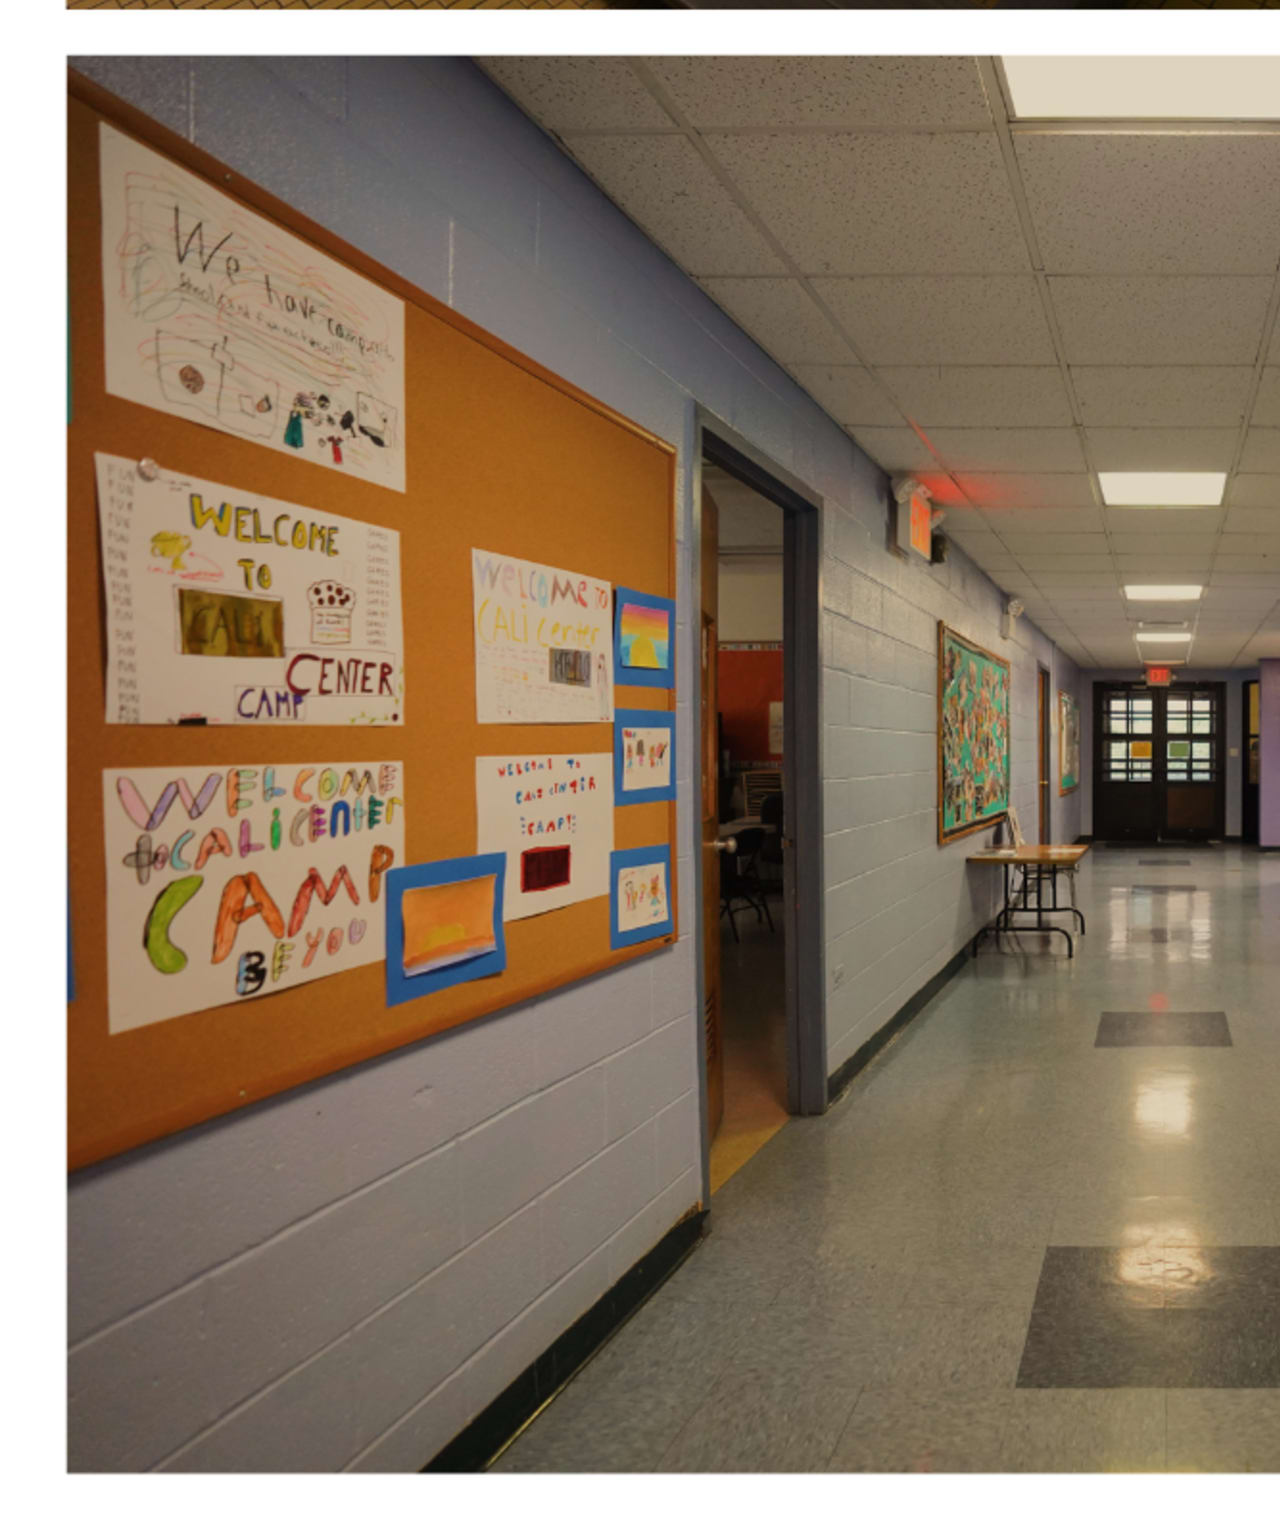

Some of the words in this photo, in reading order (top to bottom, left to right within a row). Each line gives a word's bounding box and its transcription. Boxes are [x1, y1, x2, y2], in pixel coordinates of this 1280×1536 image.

[174, 205, 240, 285] We
[265, 274, 317, 319] have
[189, 493, 340, 557] WELCOME
[237, 558, 272, 591] TO
[286, 652, 393, 696] CENTER
[237, 687, 304, 720] CAMP
[116, 763, 398, 832] WELCOME
[143, 844, 395, 975] CAMP
[302, 917, 367, 969] YOU
